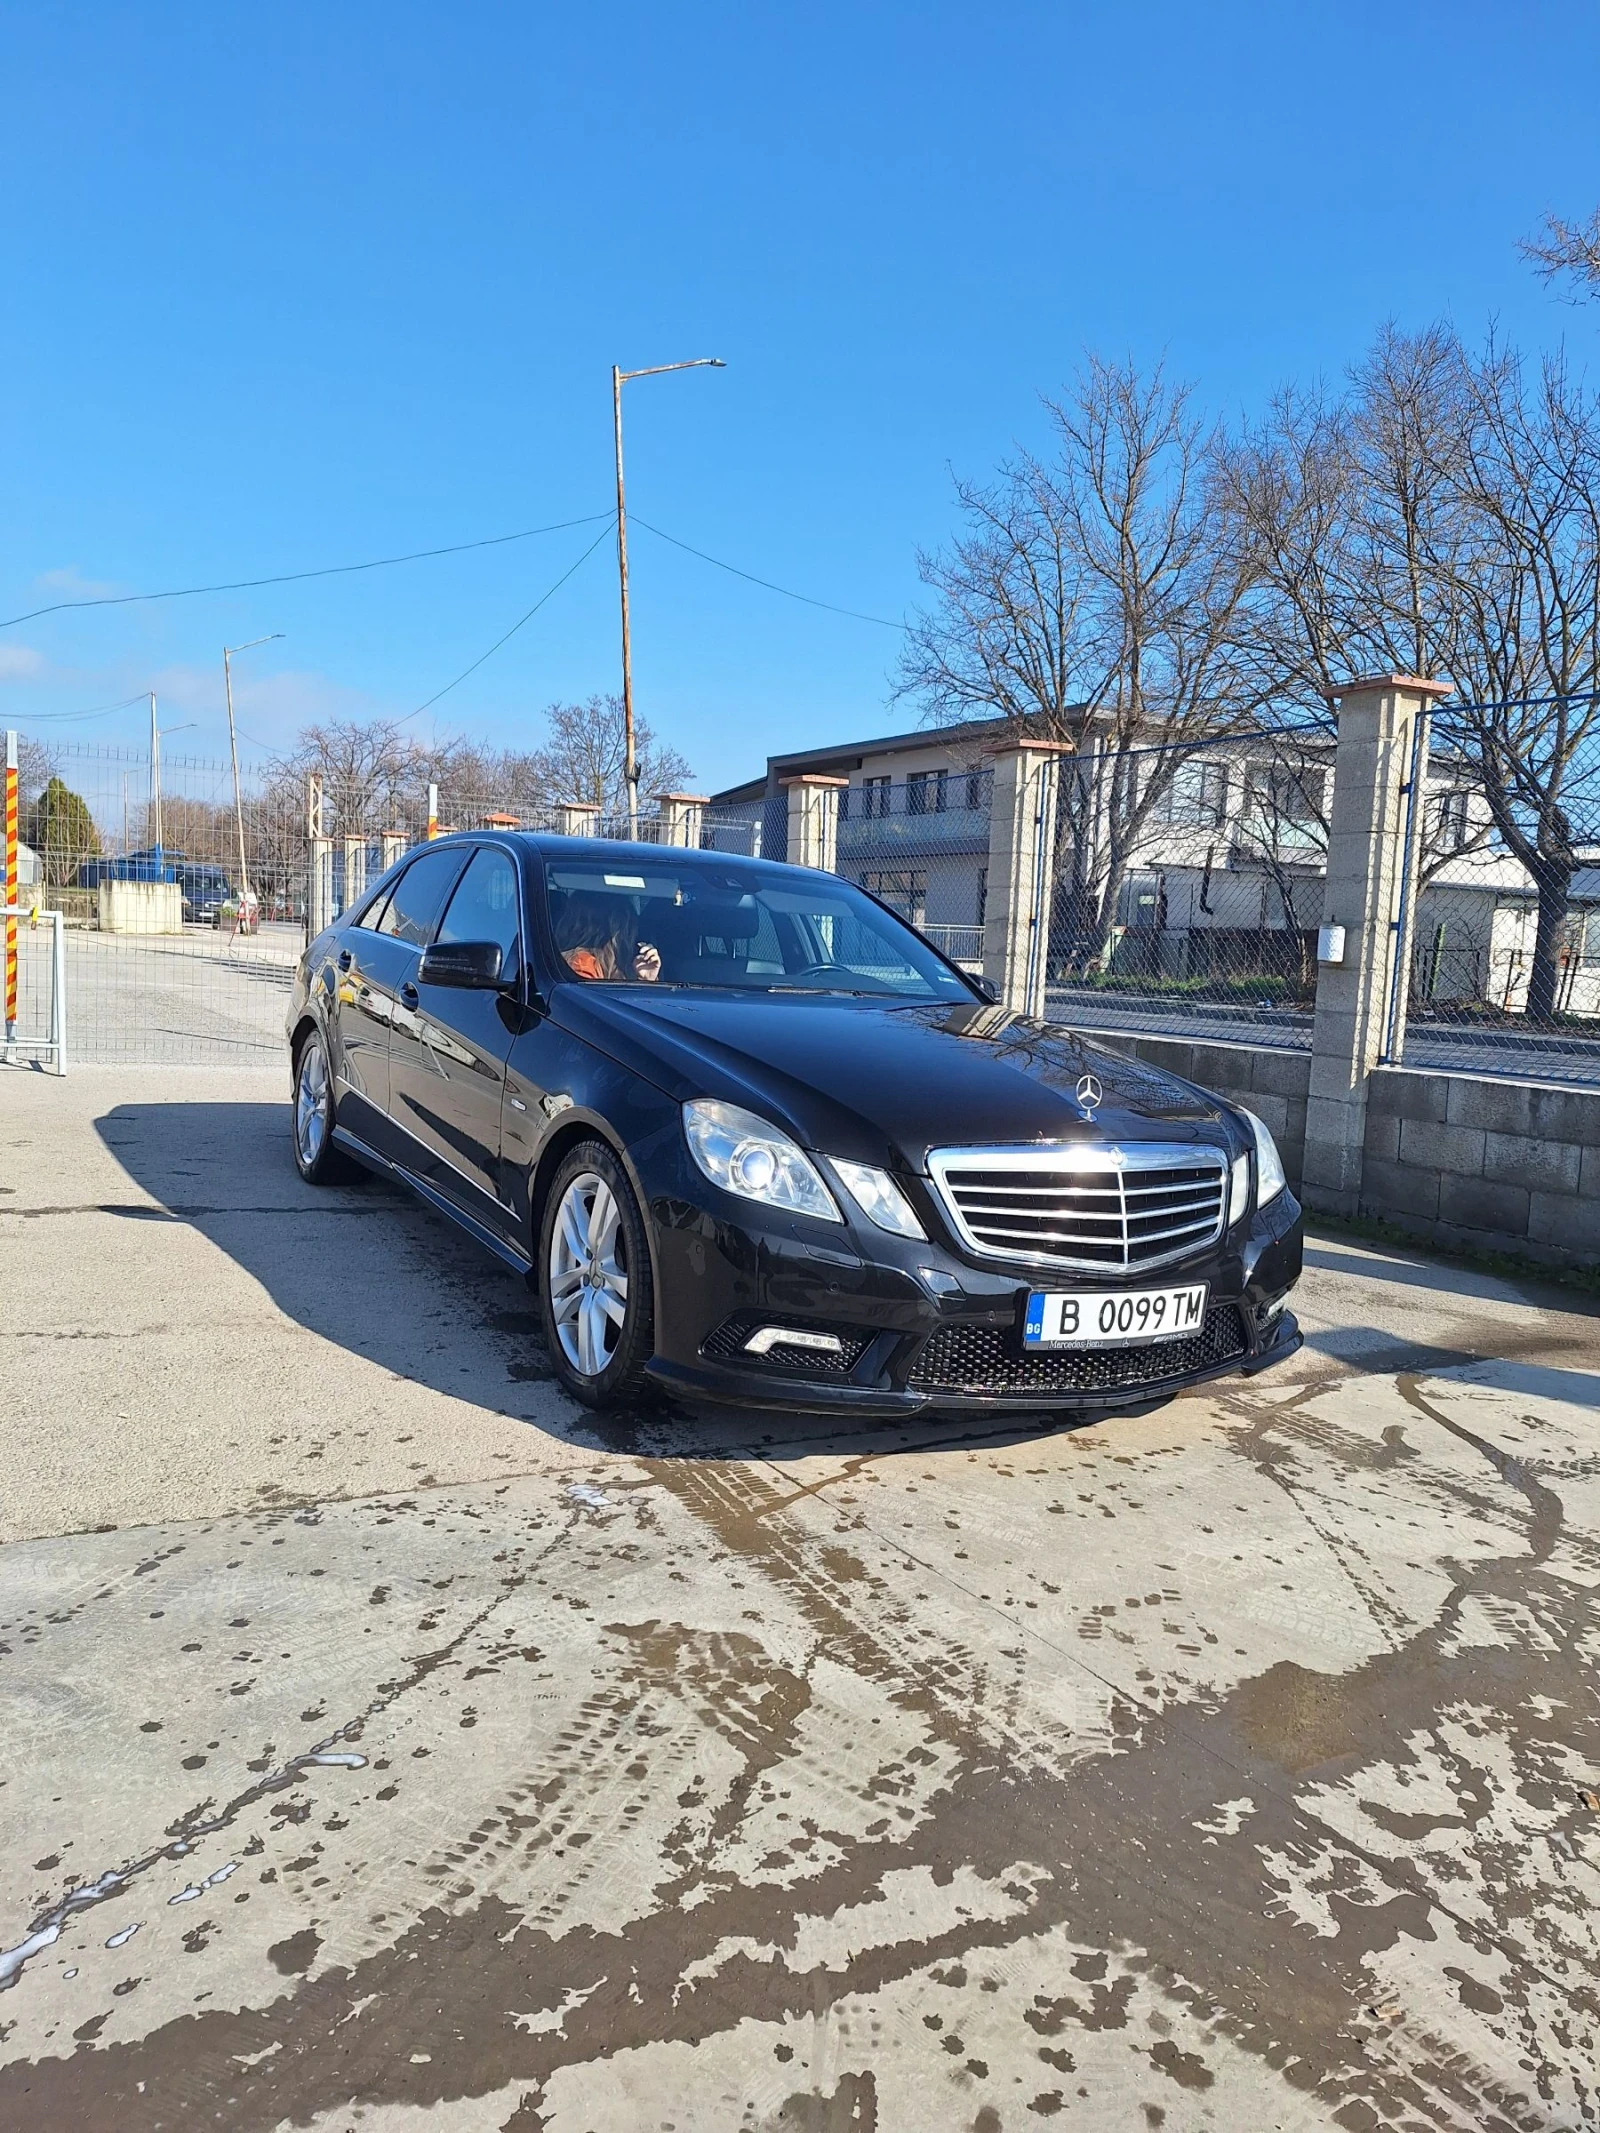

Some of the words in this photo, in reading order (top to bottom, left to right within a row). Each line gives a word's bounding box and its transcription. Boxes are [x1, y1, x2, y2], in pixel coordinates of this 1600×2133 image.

[1060, 1300, 1080, 1335] B
[1099, 1296, 1167, 1334] 0099
[1173, 1291, 1202, 1327] TM
[1026, 1323, 1041, 1334] BG
[1048, 1339, 1104, 1350] Mercedes-Benz
